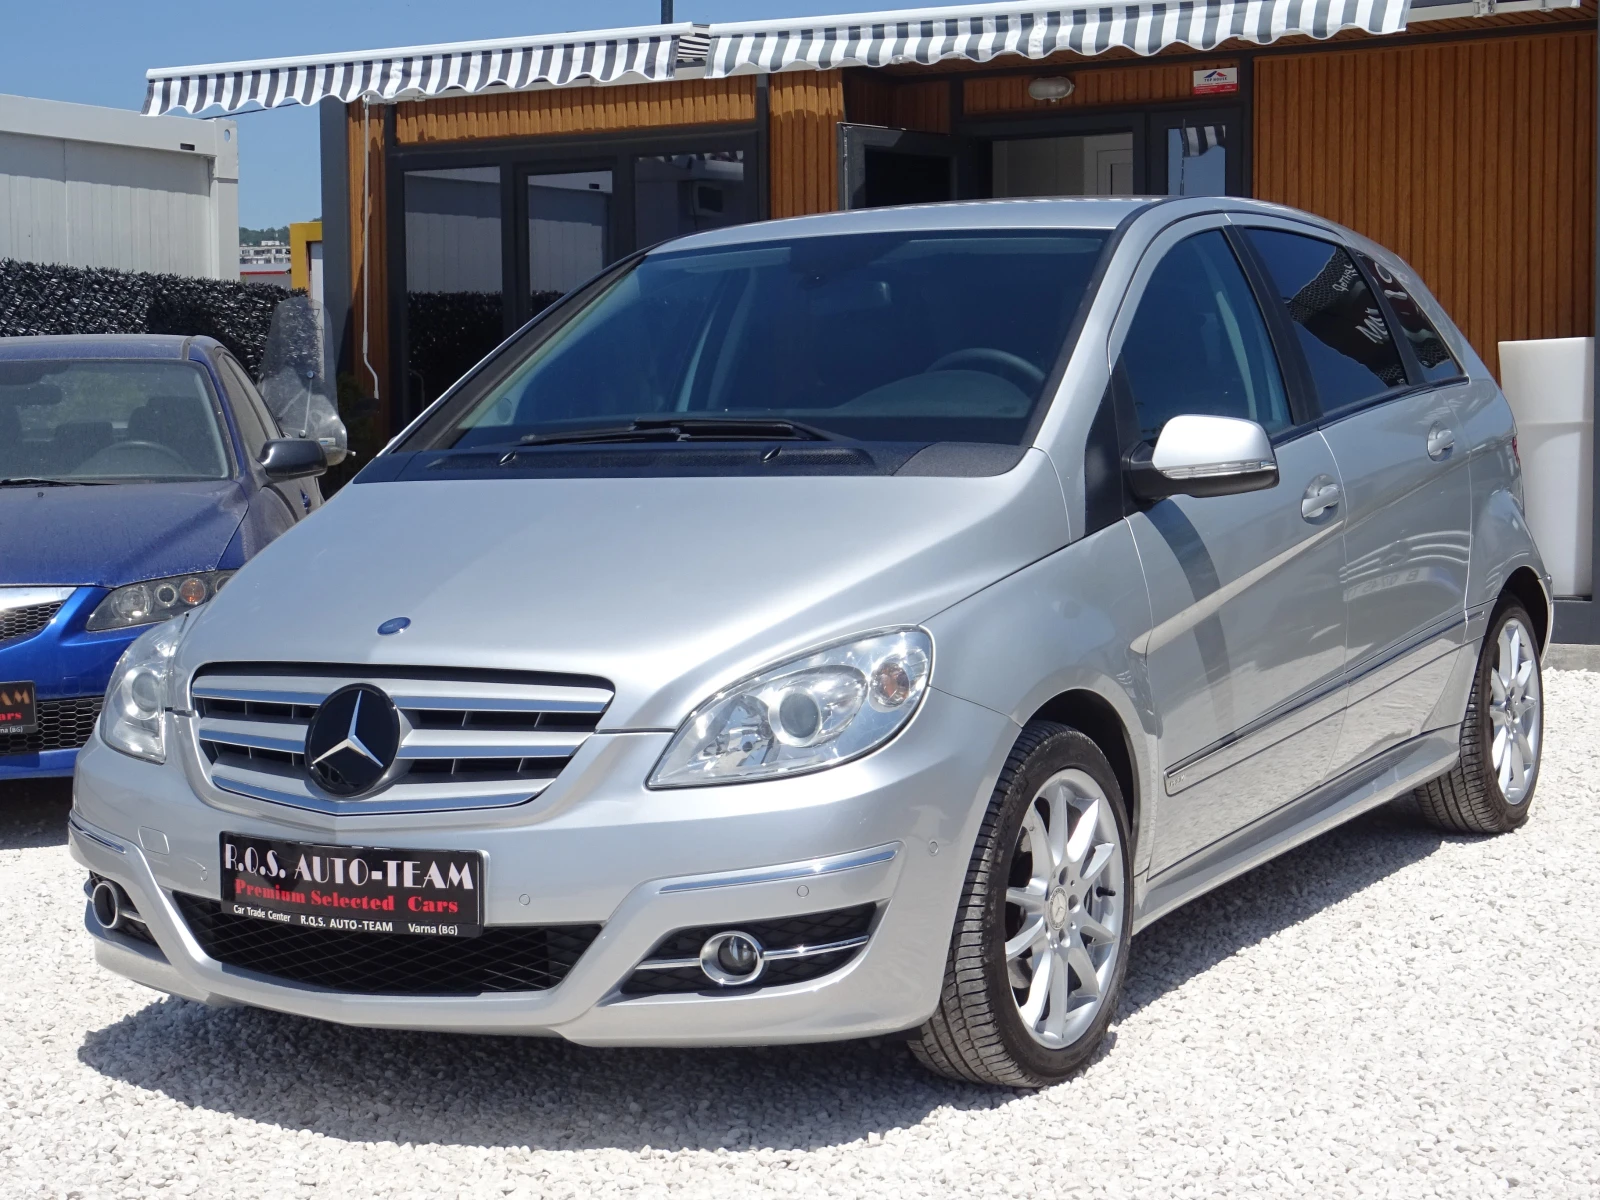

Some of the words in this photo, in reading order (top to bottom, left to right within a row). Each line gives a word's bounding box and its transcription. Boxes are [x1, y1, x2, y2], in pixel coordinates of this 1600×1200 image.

[225, 843, 286, 879] R.Q.S.
[294, 853, 474, 890] AUTO-TEAM
[234, 878, 306, 904] Premium
[311, 890, 395, 911] Selected
[407, 895, 458, 913] Cars
[233, 904, 245, 915] Car
[246, 906, 266, 919] Trade
[267, 910, 291, 923] Center
[300, 914, 326, 928] R.Q.S.
[329, 918, 393, 933] AUTO-TEAM
[408, 923, 437, 935] Varna
[438, 924, 458, 937] (BG)
